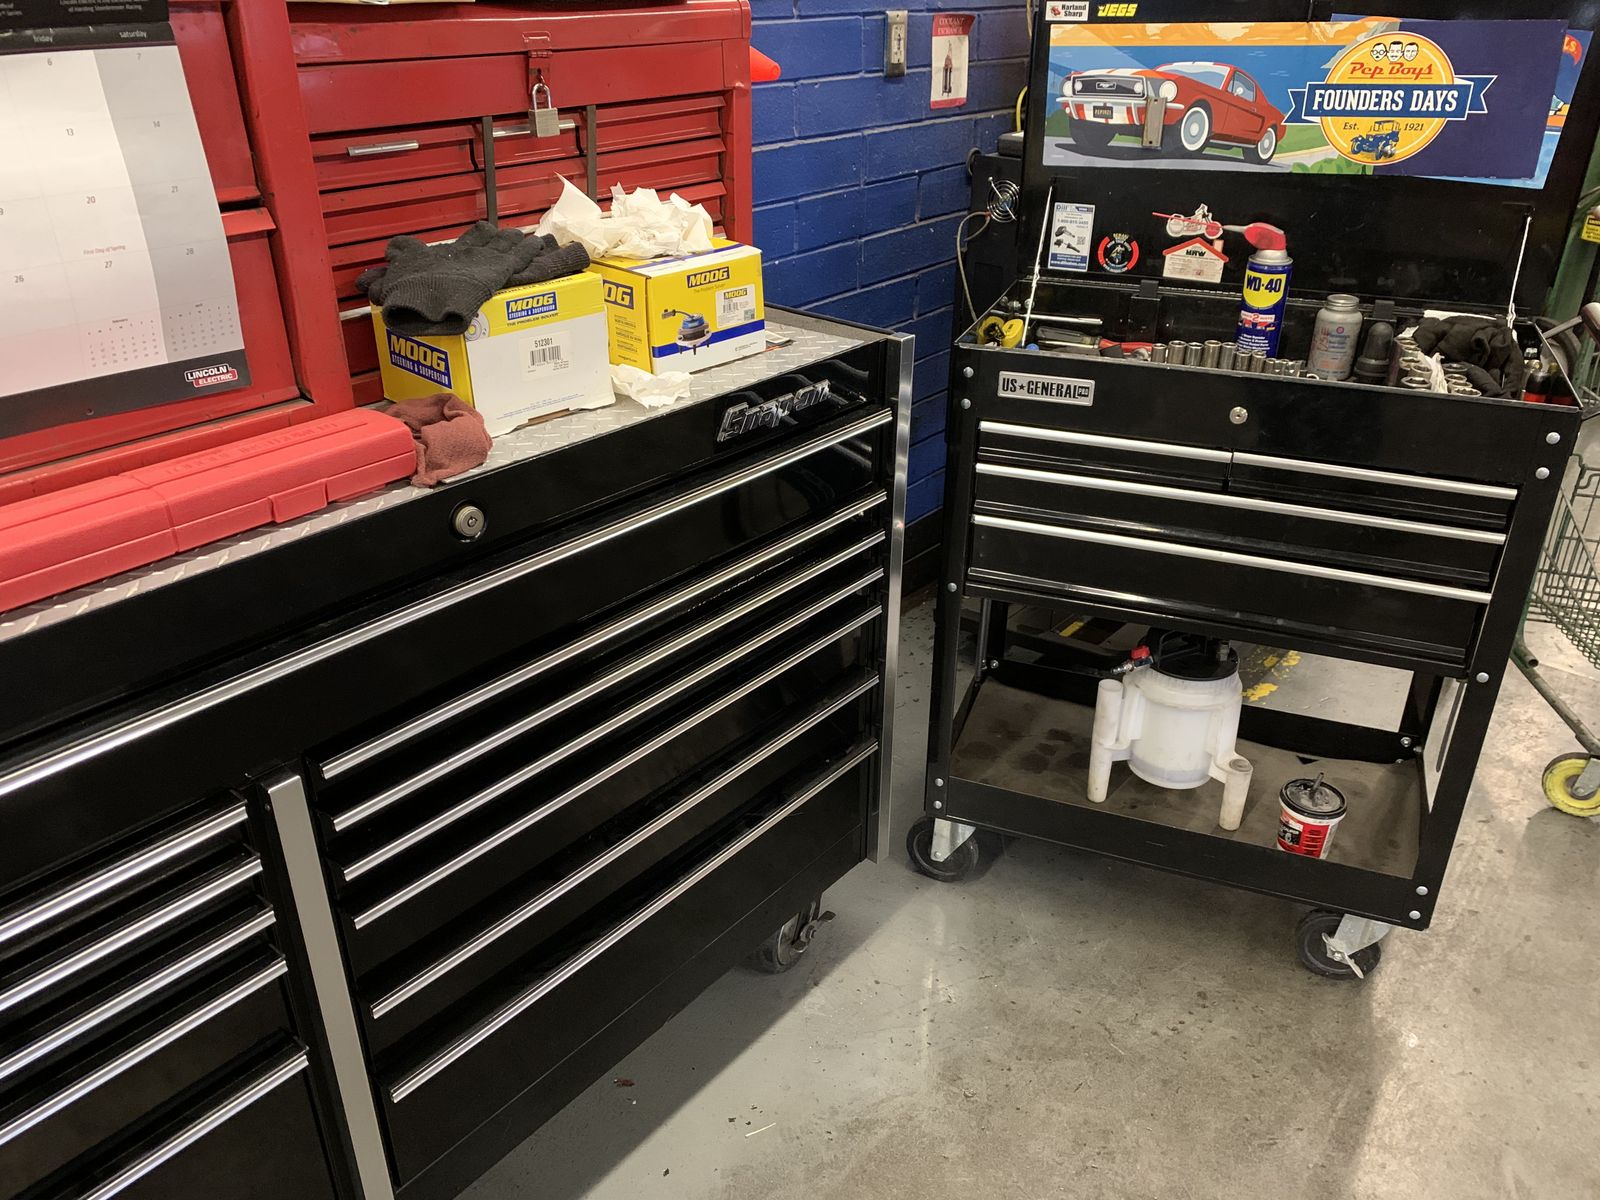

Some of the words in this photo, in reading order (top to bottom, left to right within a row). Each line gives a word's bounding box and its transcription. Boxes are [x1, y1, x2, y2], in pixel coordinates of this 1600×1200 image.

[1098, 4, 1138, 17] JEGS
[33, 35, 53, 43] friday
[119, 30, 147, 39] saturday
[47, 58, 53, 66] 6
[1350, 62, 1384, 79] Pep
[1389, 62, 1433, 80] Boys
[1312, 89, 1403, 111] FOUNDERS
[1410, 90, 1459, 112] DAYS
[66, 128, 74, 136] 13
[153, 120, 161, 128] 14
[1343, 121, 1360, 131] Est.
[1404, 123, 1424, 131] 1921
[86, 196, 96, 204] 20
[14, 275, 24, 283] 26
[104, 260, 113, 268] 27
[185, 248, 194, 256] 28
[688, 268, 728, 287] MOOG
[1246, 273, 1282, 293] WD-40
[603, 283, 631, 306] OG
[724, 288, 747, 300] MOOG
[509, 293, 554, 313] MOOG
[508, 310, 527, 320] STEERING
[532, 304, 556, 315] SUSPENSION
[517, 316, 539, 325] PROBLEM
[541, 313, 559, 321] SOLVER
[1252, 313, 1260, 321] 2
[534, 337, 553, 348] 512301
[390, 334, 446, 373] MOOG
[187, 365, 227, 380] LINCOLN
[391, 354, 413, 371] STEERING
[419, 365, 449, 385] SUSPENSION
[198, 373, 233, 385] ELECTRIC
[1002, 378, 1017, 392] US
[1027, 380, 1078, 399] GENERAL
